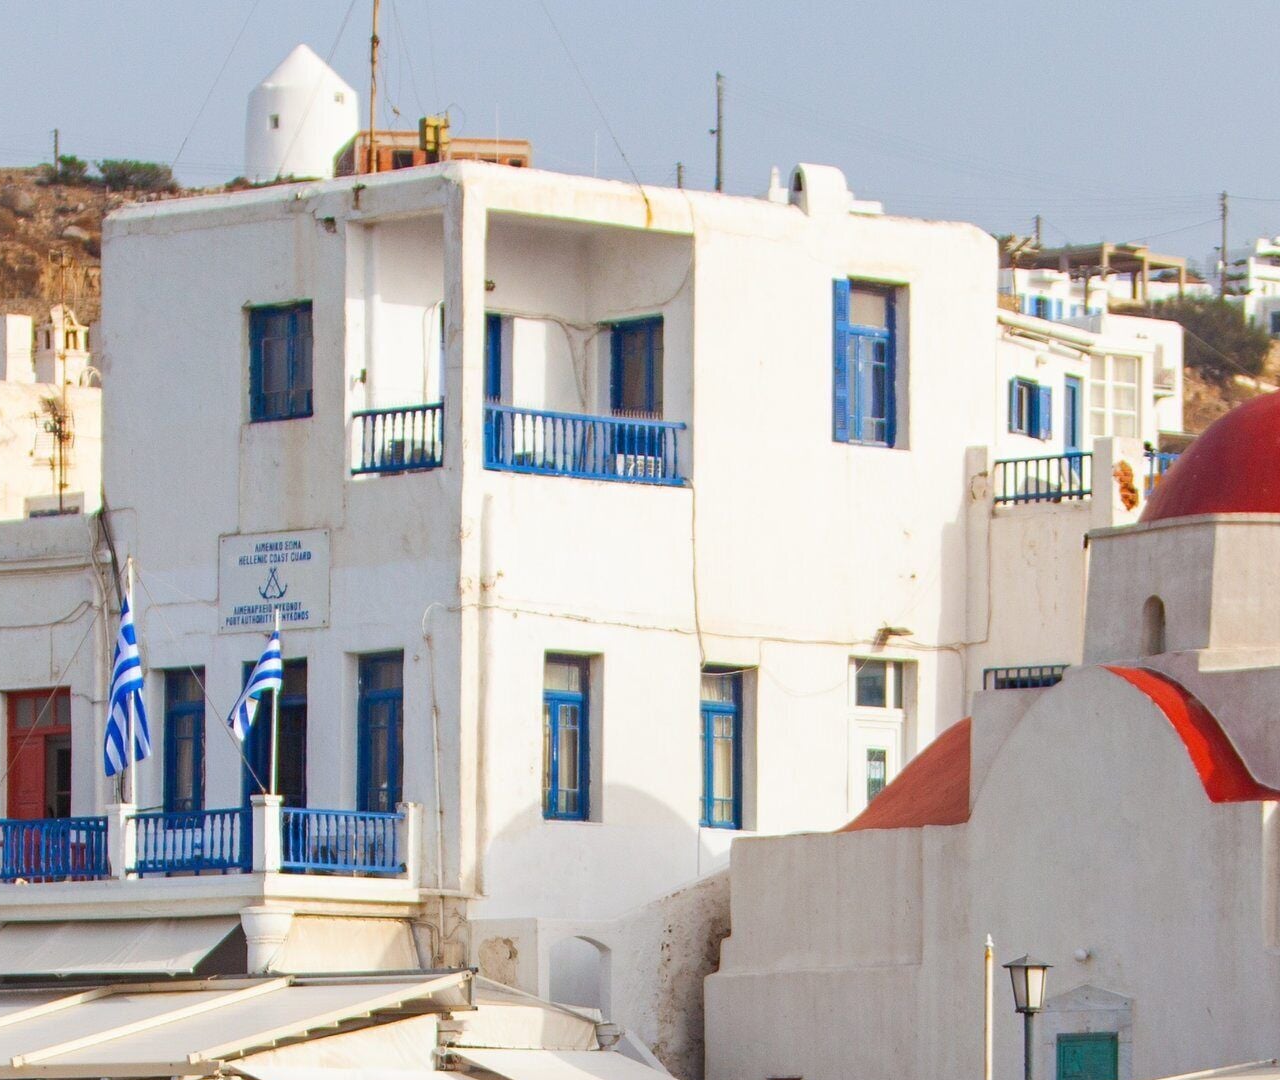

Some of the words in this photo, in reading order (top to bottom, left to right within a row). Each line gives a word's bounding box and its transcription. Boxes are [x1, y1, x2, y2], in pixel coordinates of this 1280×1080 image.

[239, 554, 267, 565] HELLENIC
[269, 553, 288, 564] COAST
[290, 551, 312, 561] GUARD
[226, 616, 240, 626] PORT
[241, 614, 272, 624] AUTHORITY
[282, 611, 308, 621] MYKONOS
